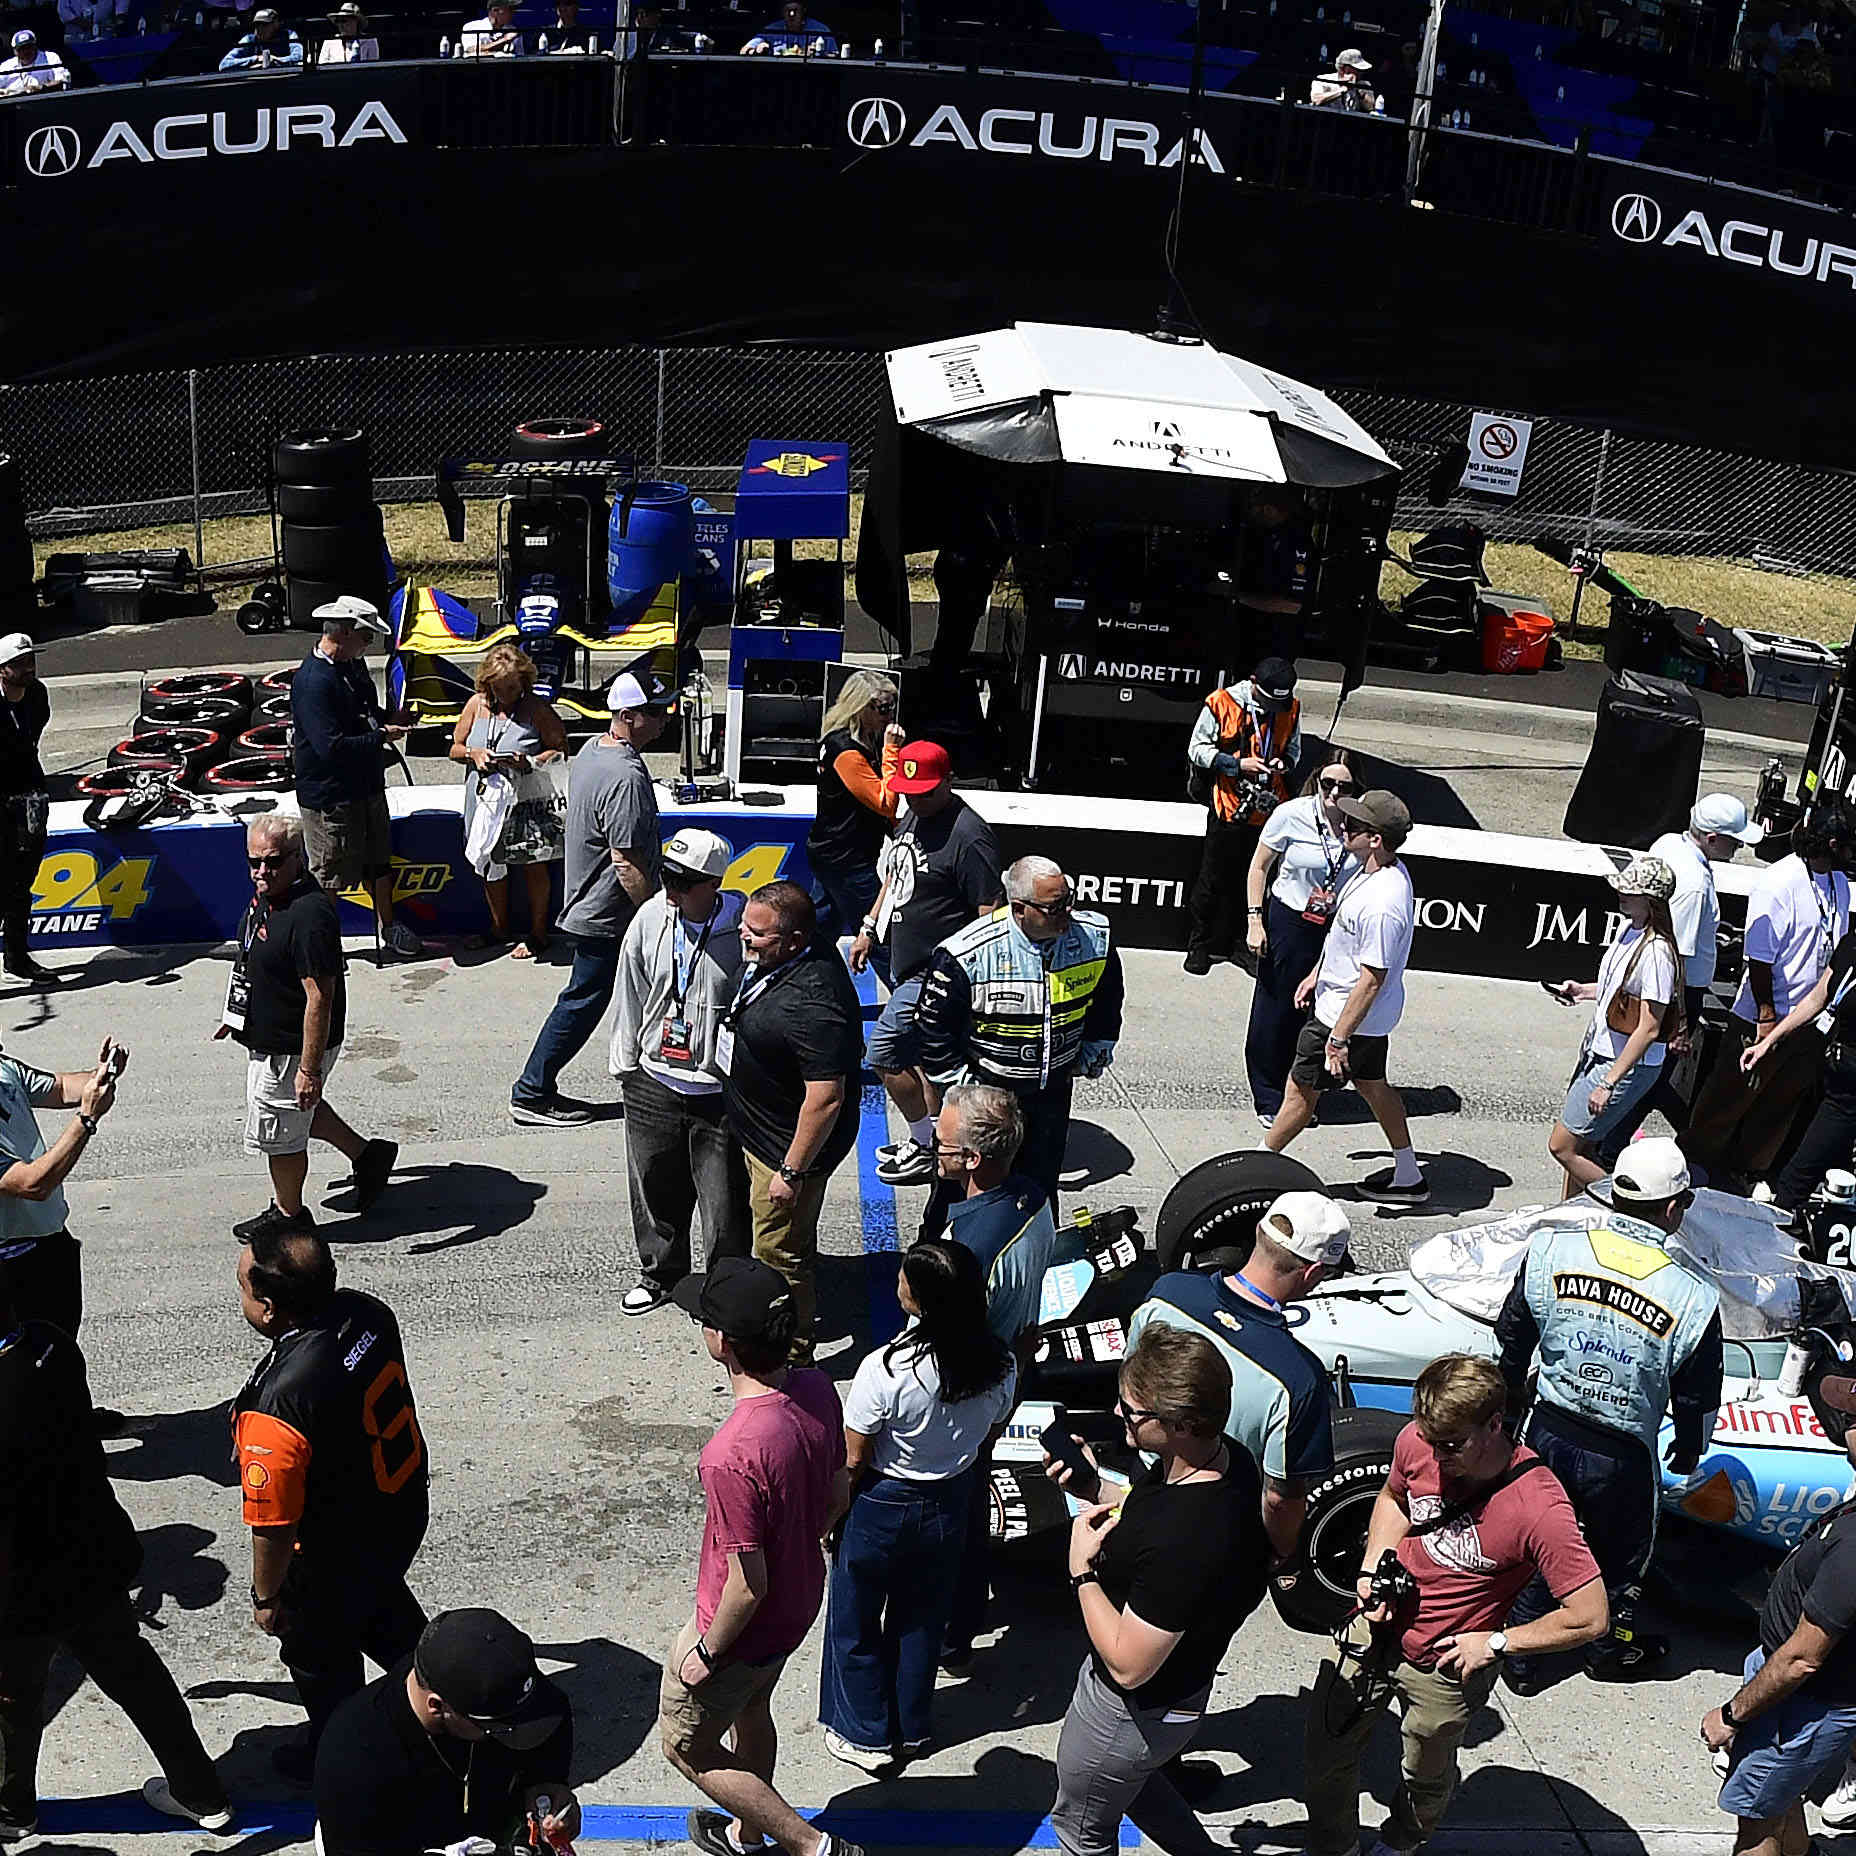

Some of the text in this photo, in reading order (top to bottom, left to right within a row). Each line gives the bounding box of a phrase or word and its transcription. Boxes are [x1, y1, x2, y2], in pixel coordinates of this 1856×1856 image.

[88, 100, 408, 169] ACURA
[911, 105, 1225, 174] ACURA
[695, 533, 726, 544] CANS
[697, 523, 728, 534] TTLES
[1115, 620, 1169, 633] Honda
[1094, 660, 1200, 685] ANDRETTI
[30, 848, 157, 922] 94
[717, 842, 794, 896] 4
[1065, 874, 1184, 909] RETTI
[1527, 904, 1593, 947] JM
[1194, 1199, 1273, 1241] Firestone
[1555, 1306, 1586, 1317] COLD
[1559, 1276, 1667, 1335] JAVA HOUSE
[342, 1329, 378, 1373] SIEGEL
[1567, 1330, 1635, 1366] Splenda
[363, 1359, 421, 1495] 6
[990, 1468, 1022, 1500] PEEL
[1307, 1463, 1392, 1503] irestone
